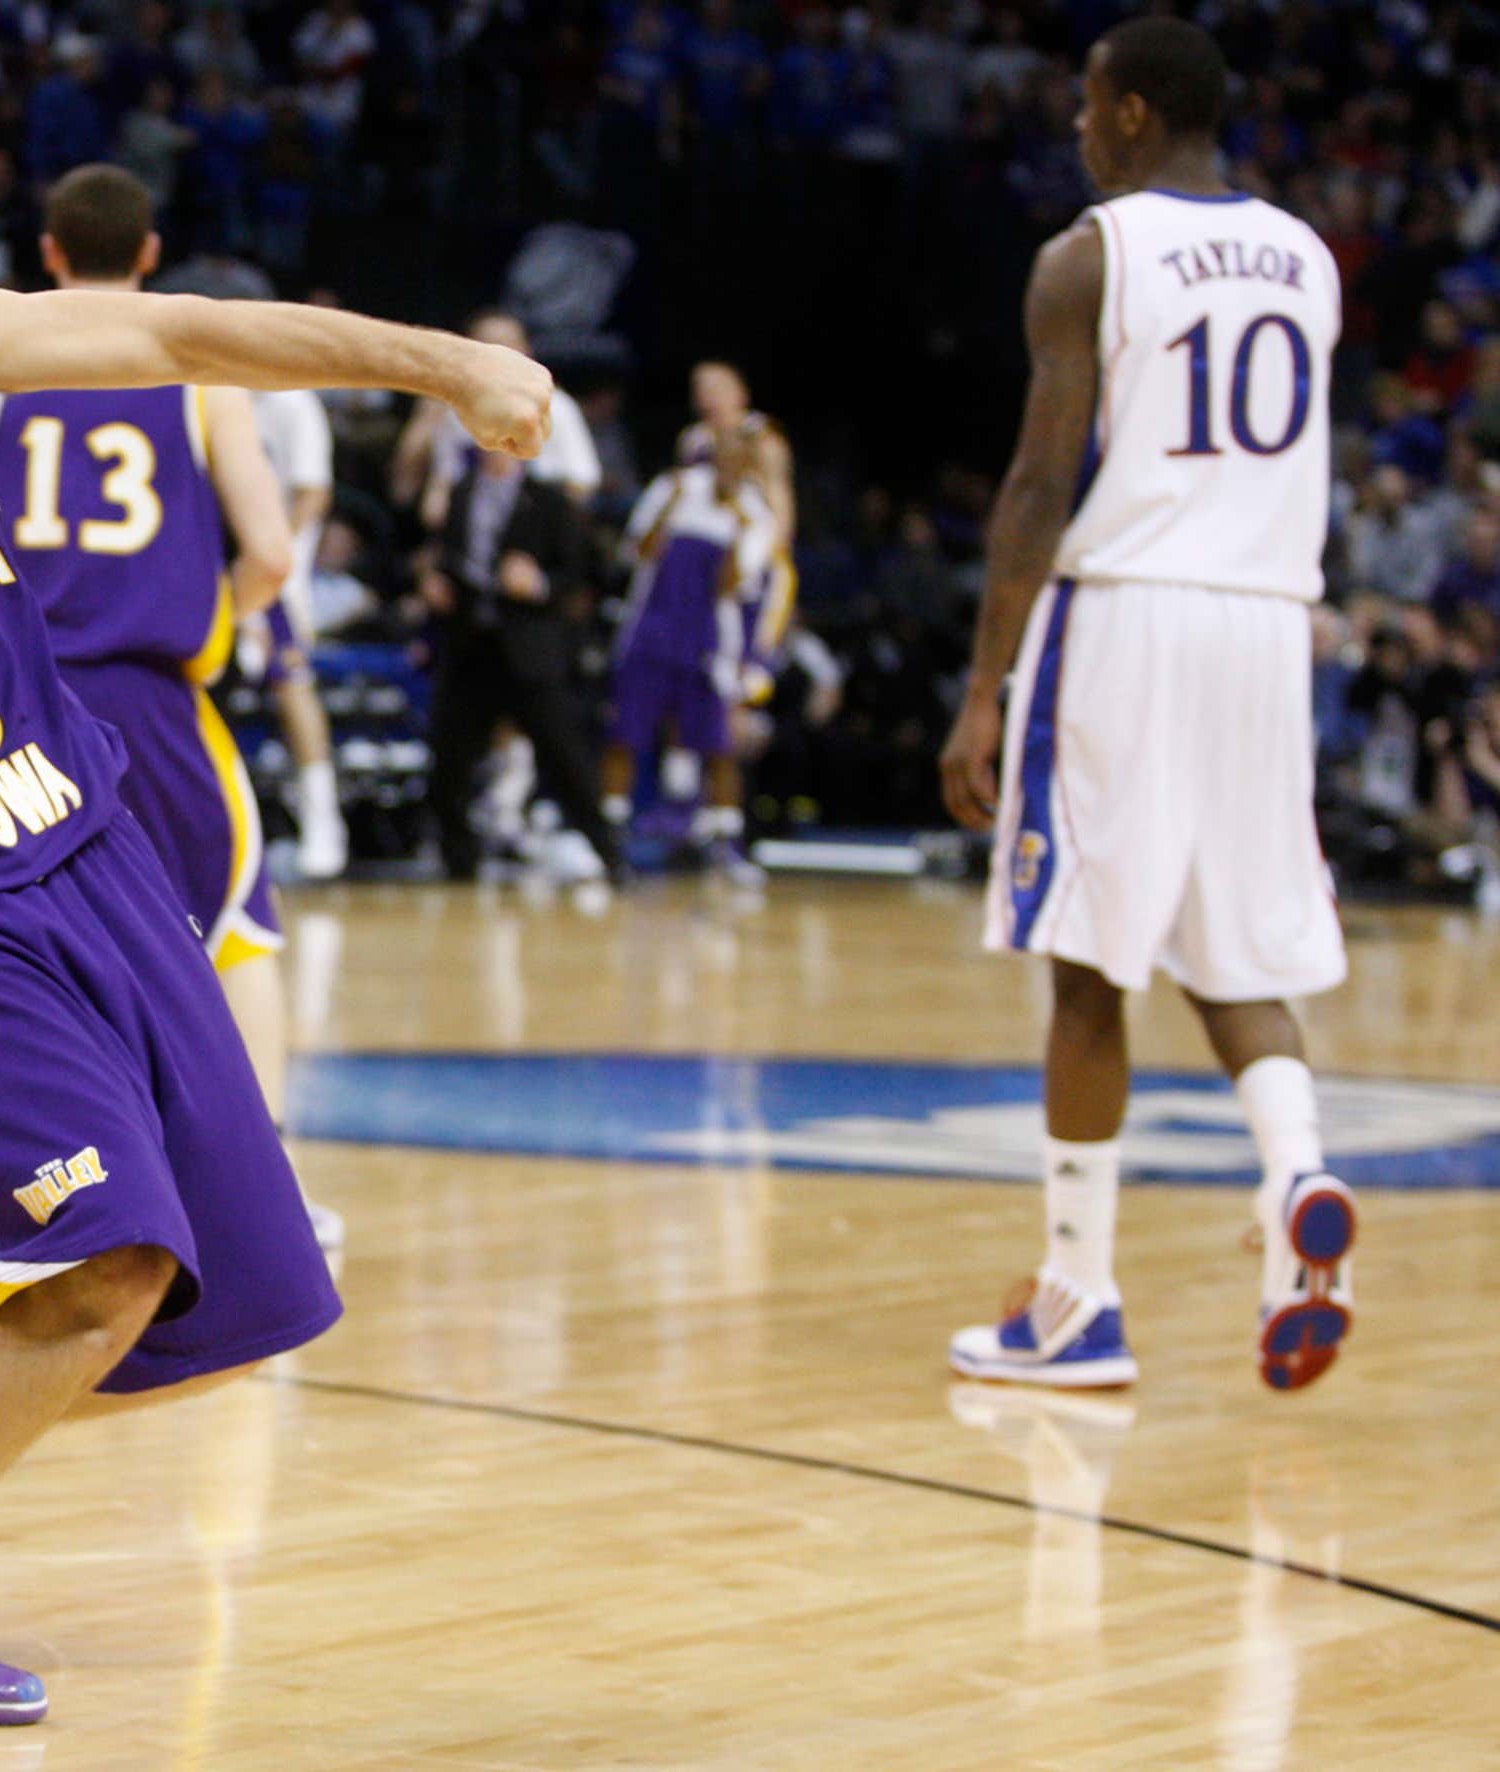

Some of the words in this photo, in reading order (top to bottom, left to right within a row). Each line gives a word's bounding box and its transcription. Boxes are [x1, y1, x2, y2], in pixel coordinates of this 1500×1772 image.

[1160, 240, 1306, 291] TAYLOR
[1163, 313, 1311, 457] 10
[14, 416, 163, 555] 13
